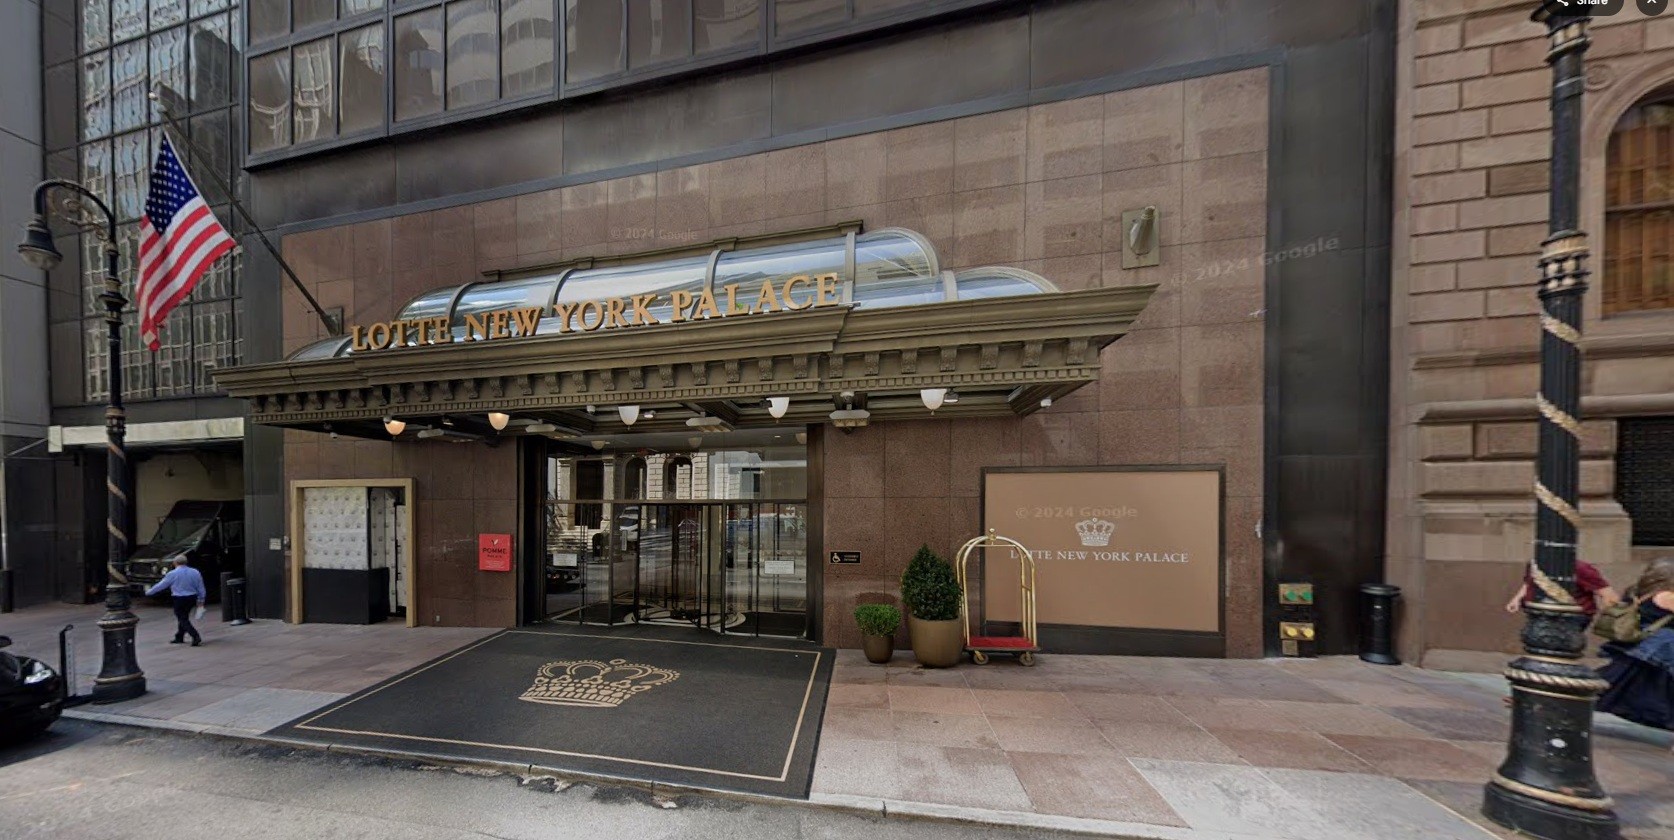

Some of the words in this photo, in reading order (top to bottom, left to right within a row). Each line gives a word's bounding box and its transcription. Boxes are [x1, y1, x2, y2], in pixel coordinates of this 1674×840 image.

[351, 316, 452, 350] LOTTE
[464, 306, 544, 342] NEW
[553, 293, 659, 333] YORK
[670, 272, 840, 323] PALACE
[1010, 549, 1052, 560] LTTE
[1057, 550, 1088, 561] NEW
[1093, 551, 1130, 562] YORK
[1135, 552, 1190, 564] PALACE
